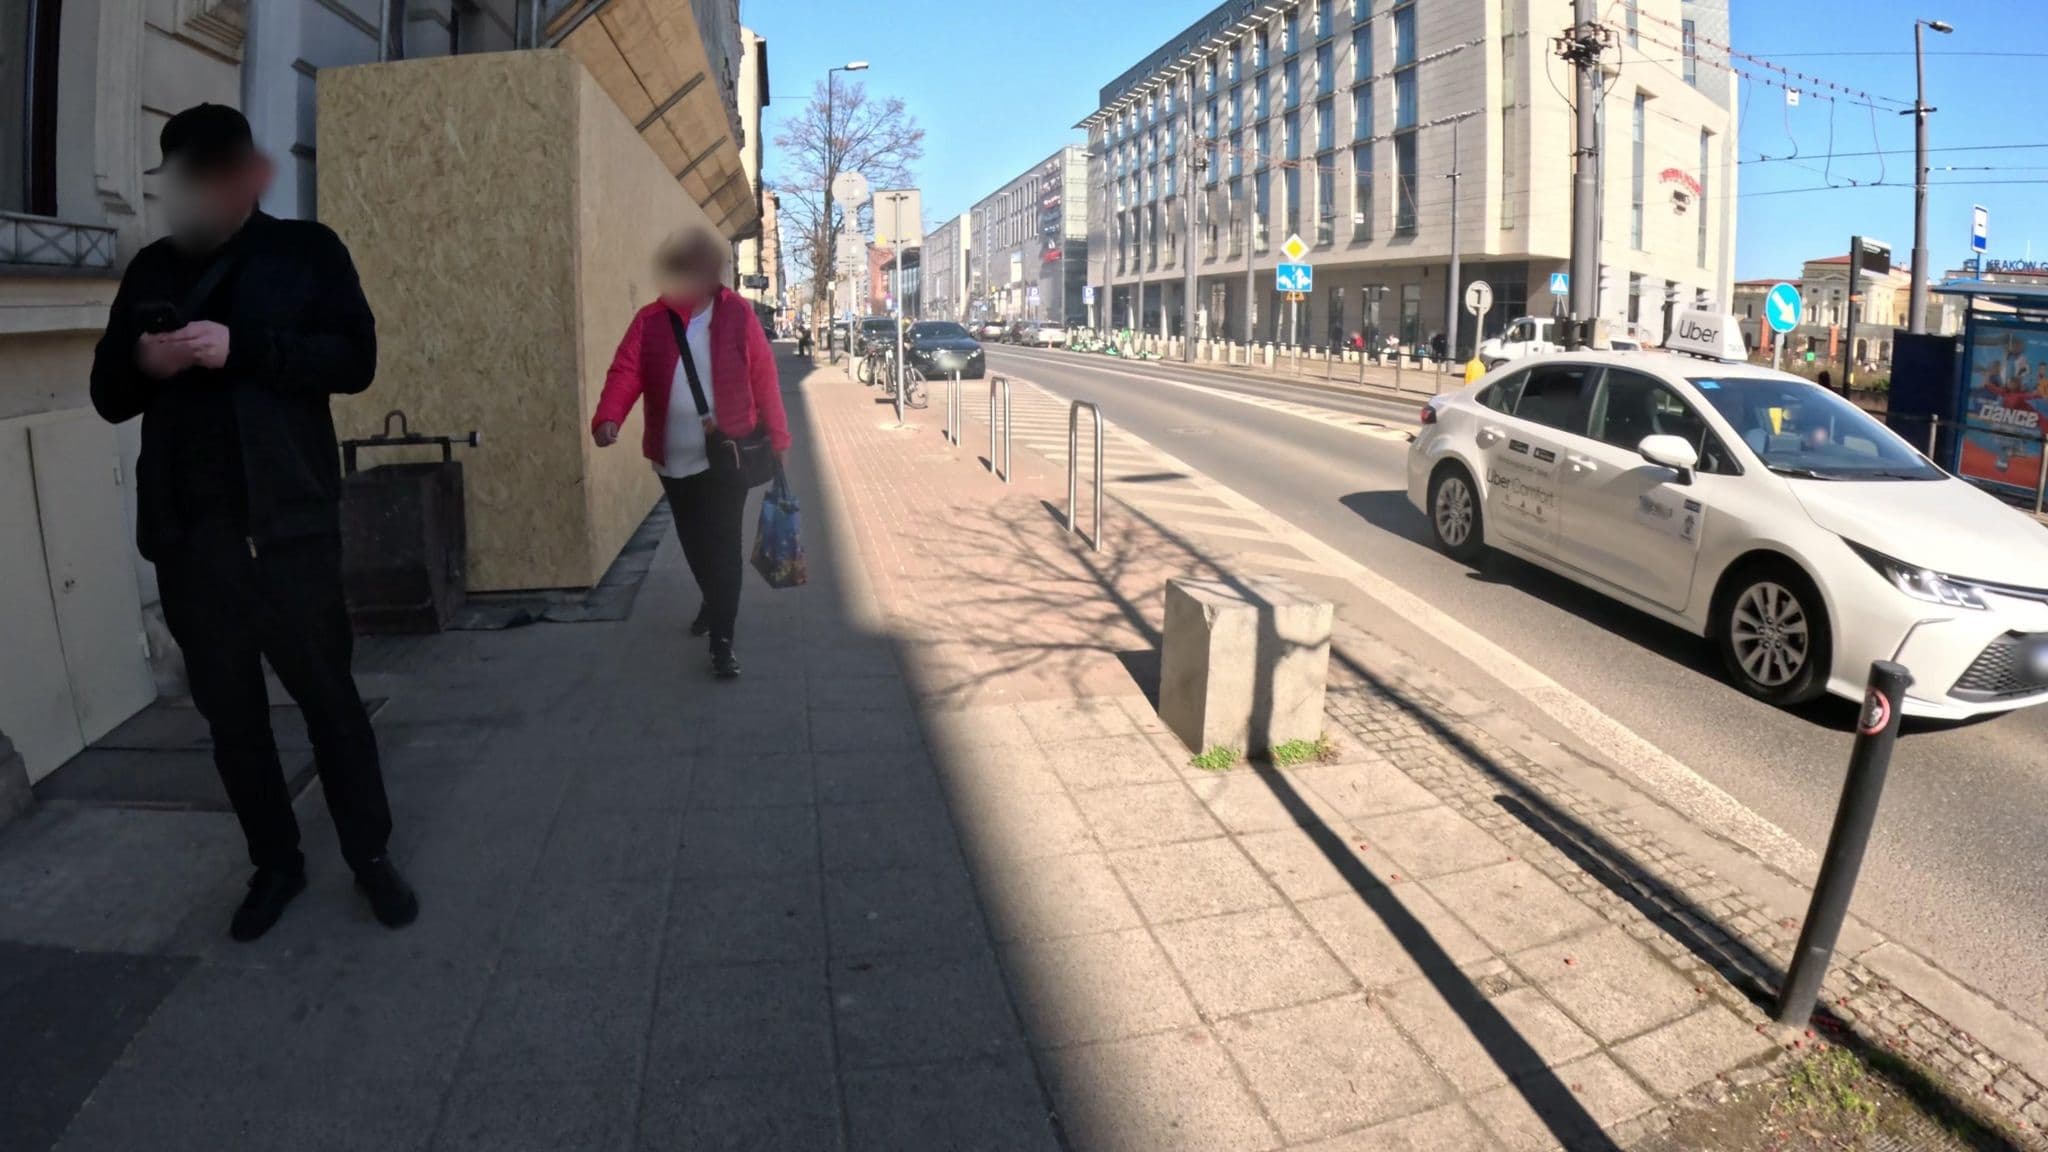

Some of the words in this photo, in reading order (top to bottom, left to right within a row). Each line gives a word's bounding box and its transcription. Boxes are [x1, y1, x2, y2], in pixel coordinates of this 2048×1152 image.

[1986, 258, 2036, 273] KRAKÓW
[1679, 319, 1718, 343] Uber
[1486, 467, 1510, 489] Uber
